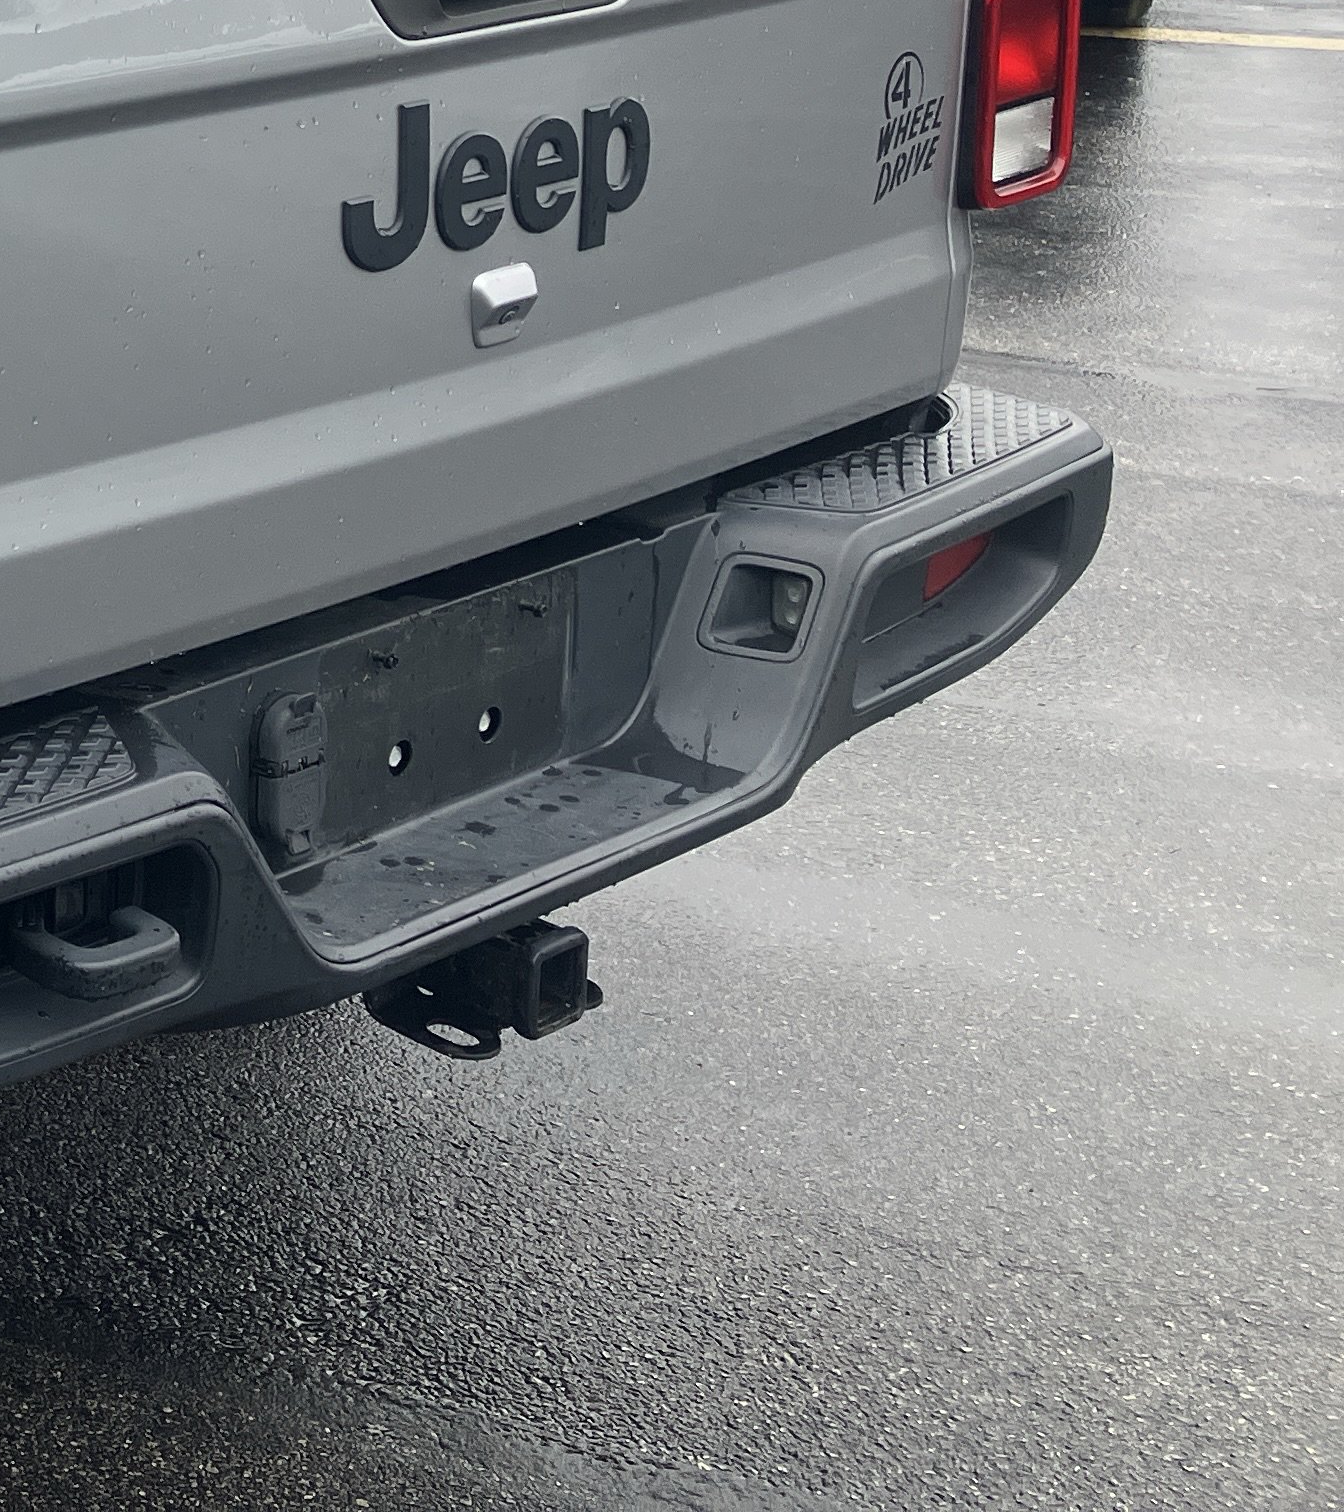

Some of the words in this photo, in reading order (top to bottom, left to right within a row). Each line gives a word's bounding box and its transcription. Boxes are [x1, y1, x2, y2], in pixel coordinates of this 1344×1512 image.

[891, 60, 912, 109] 4
[876, 95, 944, 163] WHEEL
[341, 95, 651, 273] Jeep
[873, 134, 941, 205] DRIVE
